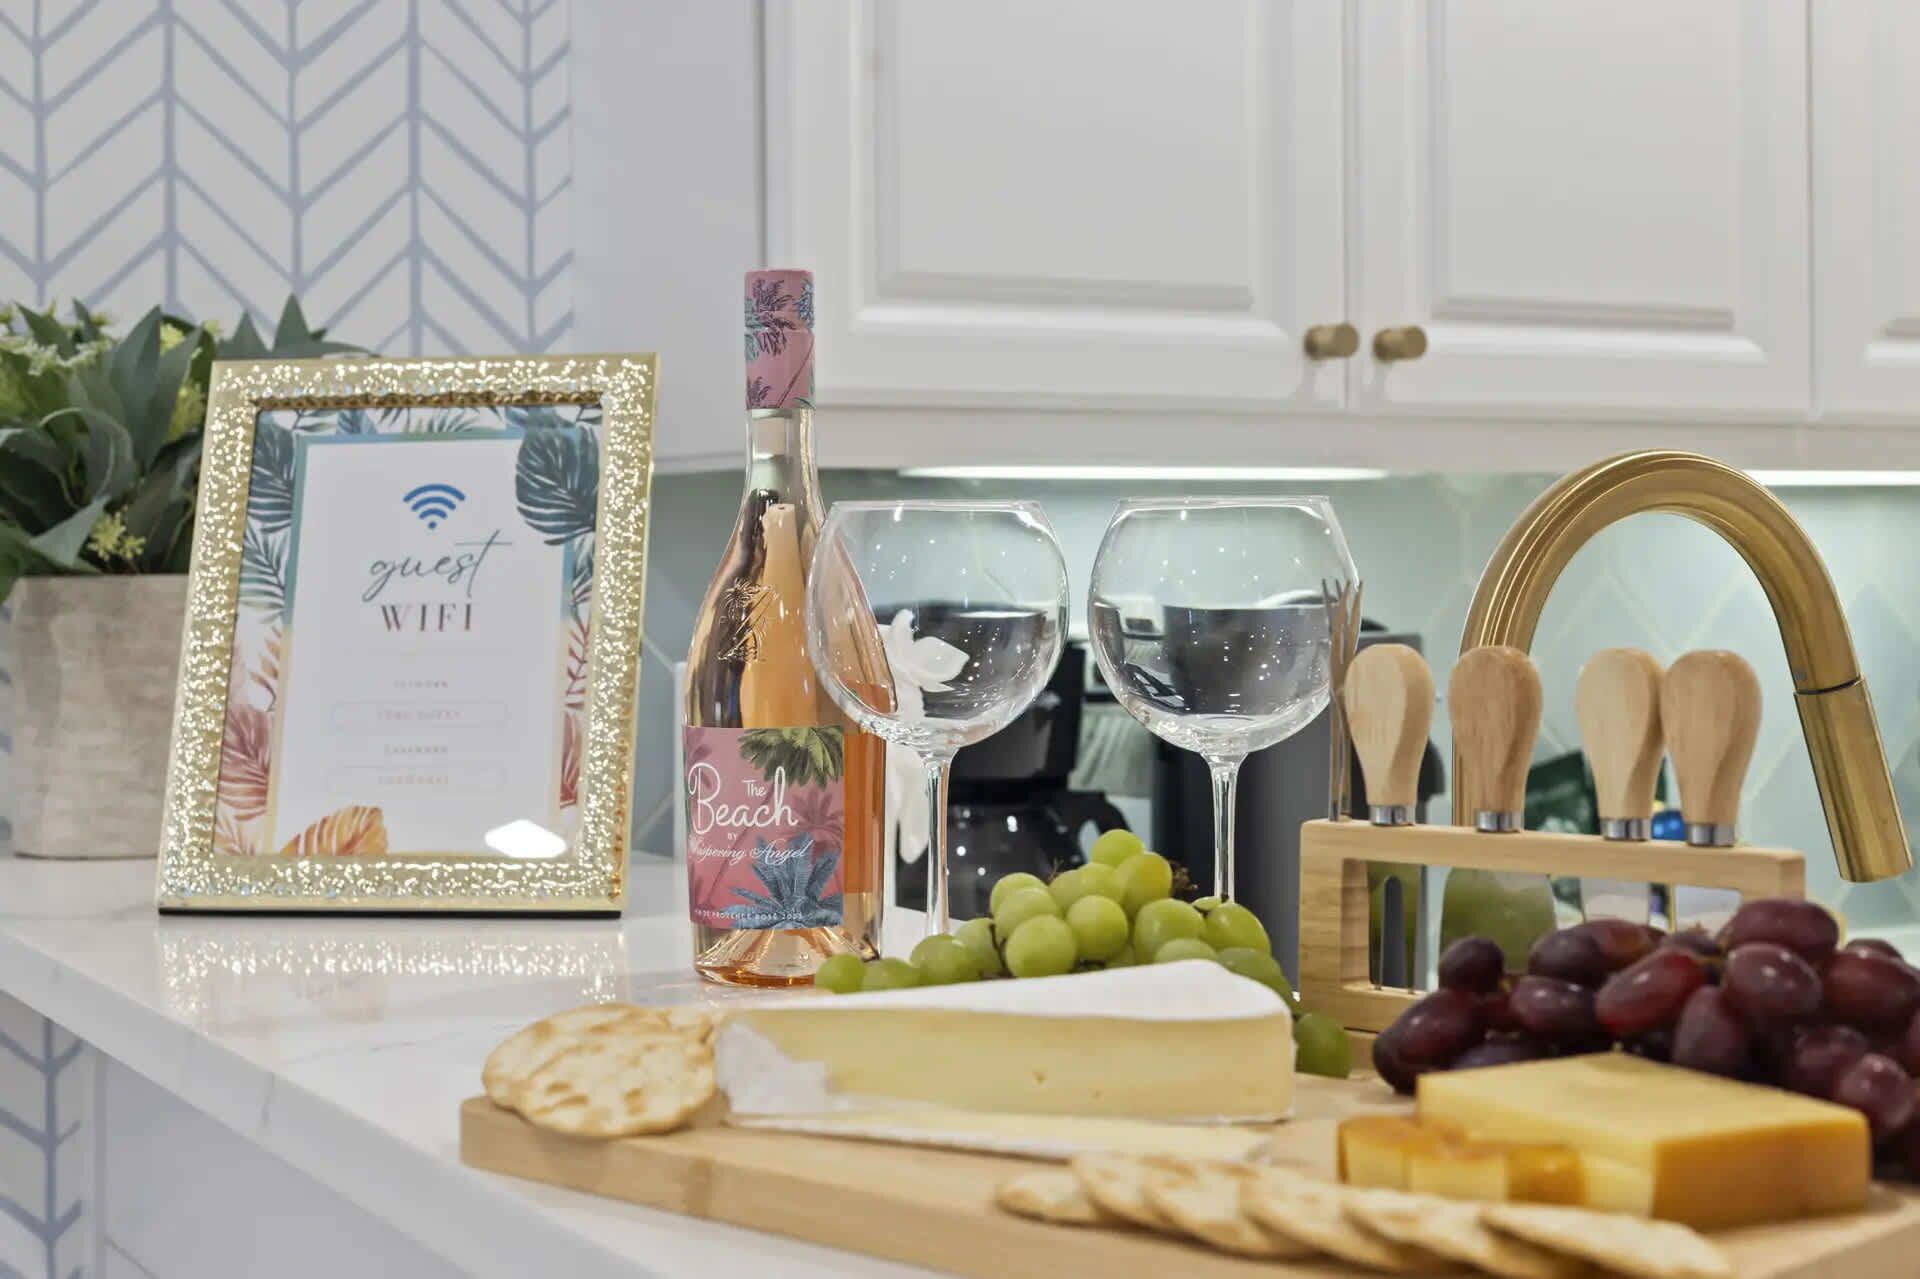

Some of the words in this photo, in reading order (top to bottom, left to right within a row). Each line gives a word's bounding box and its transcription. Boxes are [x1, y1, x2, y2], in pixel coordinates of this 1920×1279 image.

[362, 529, 513, 602] guest
[380, 603, 472, 632] WIFI
[687, 762, 799, 835] Beach
[742, 779, 767, 798] The
[727, 832, 737, 841] BY
[749, 839, 814, 866] Angel
